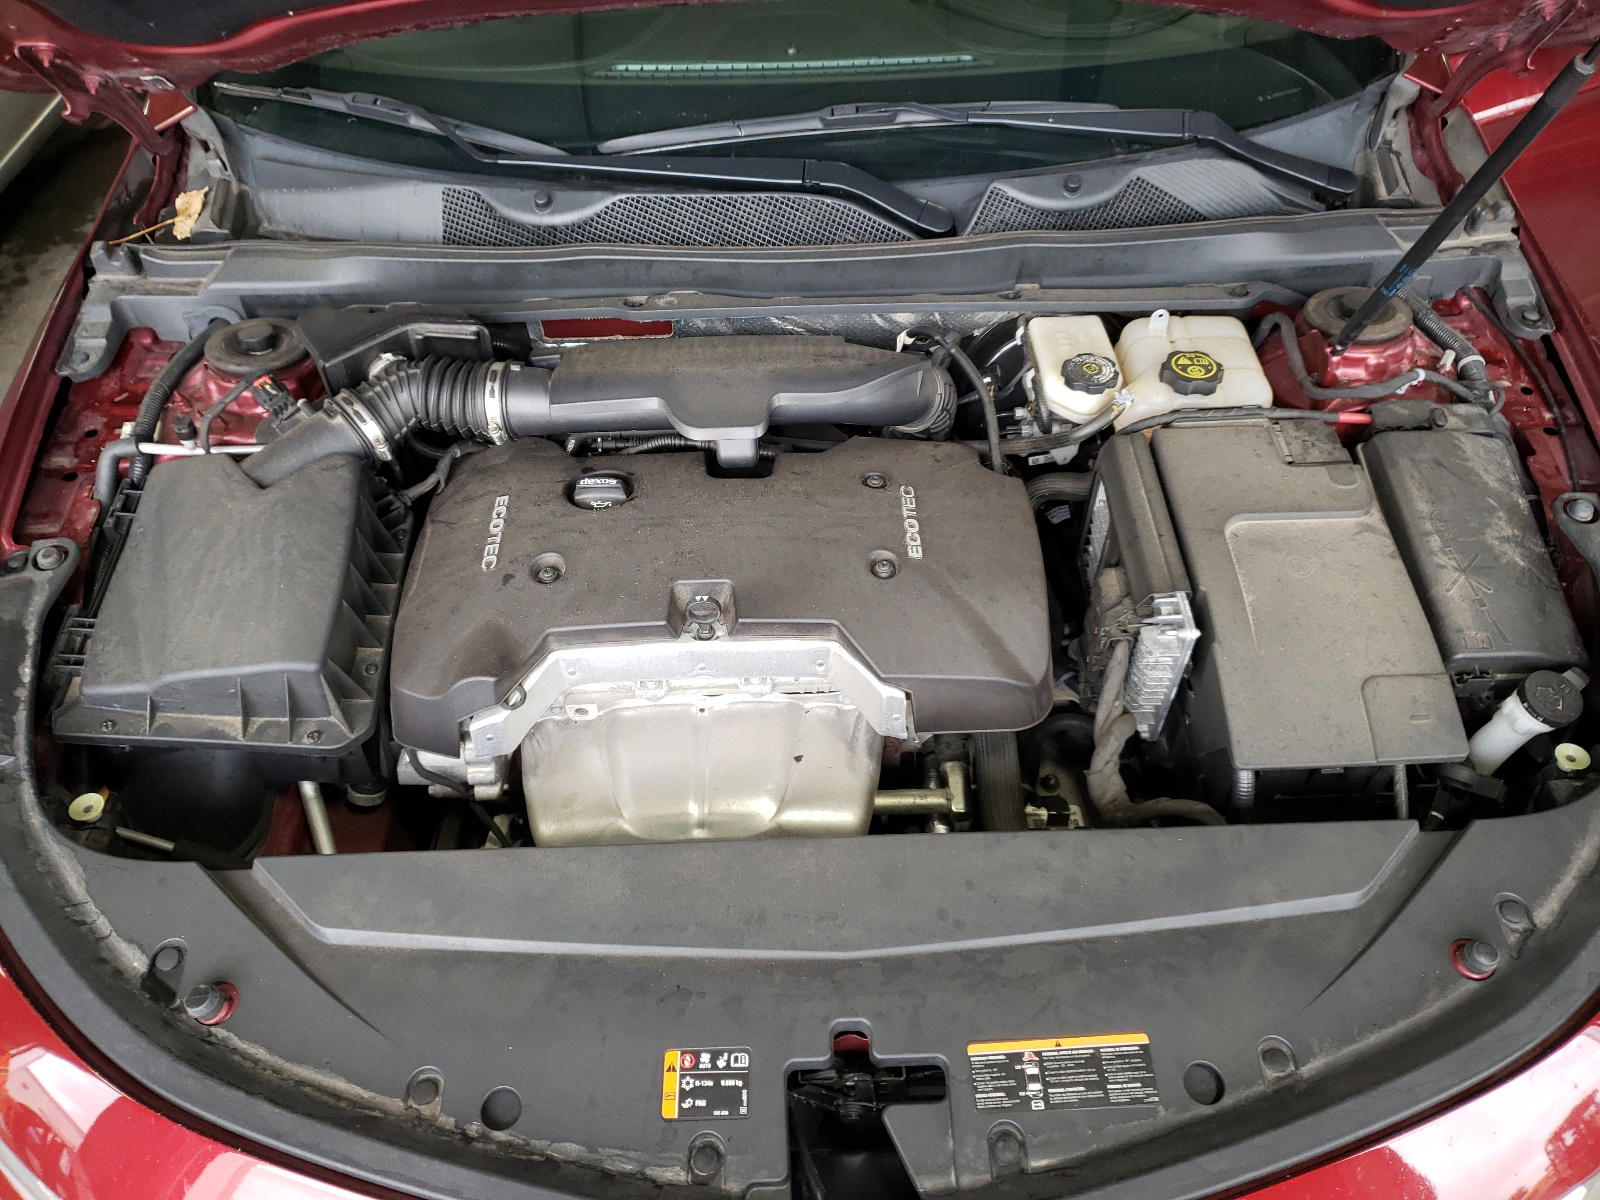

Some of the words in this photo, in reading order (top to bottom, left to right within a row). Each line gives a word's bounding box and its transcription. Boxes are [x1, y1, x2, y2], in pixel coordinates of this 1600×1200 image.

[579, 477, 617, 485] dexos
[481, 494, 510, 571] ECOTEC
[899, 485, 923, 559] ECOTEC
